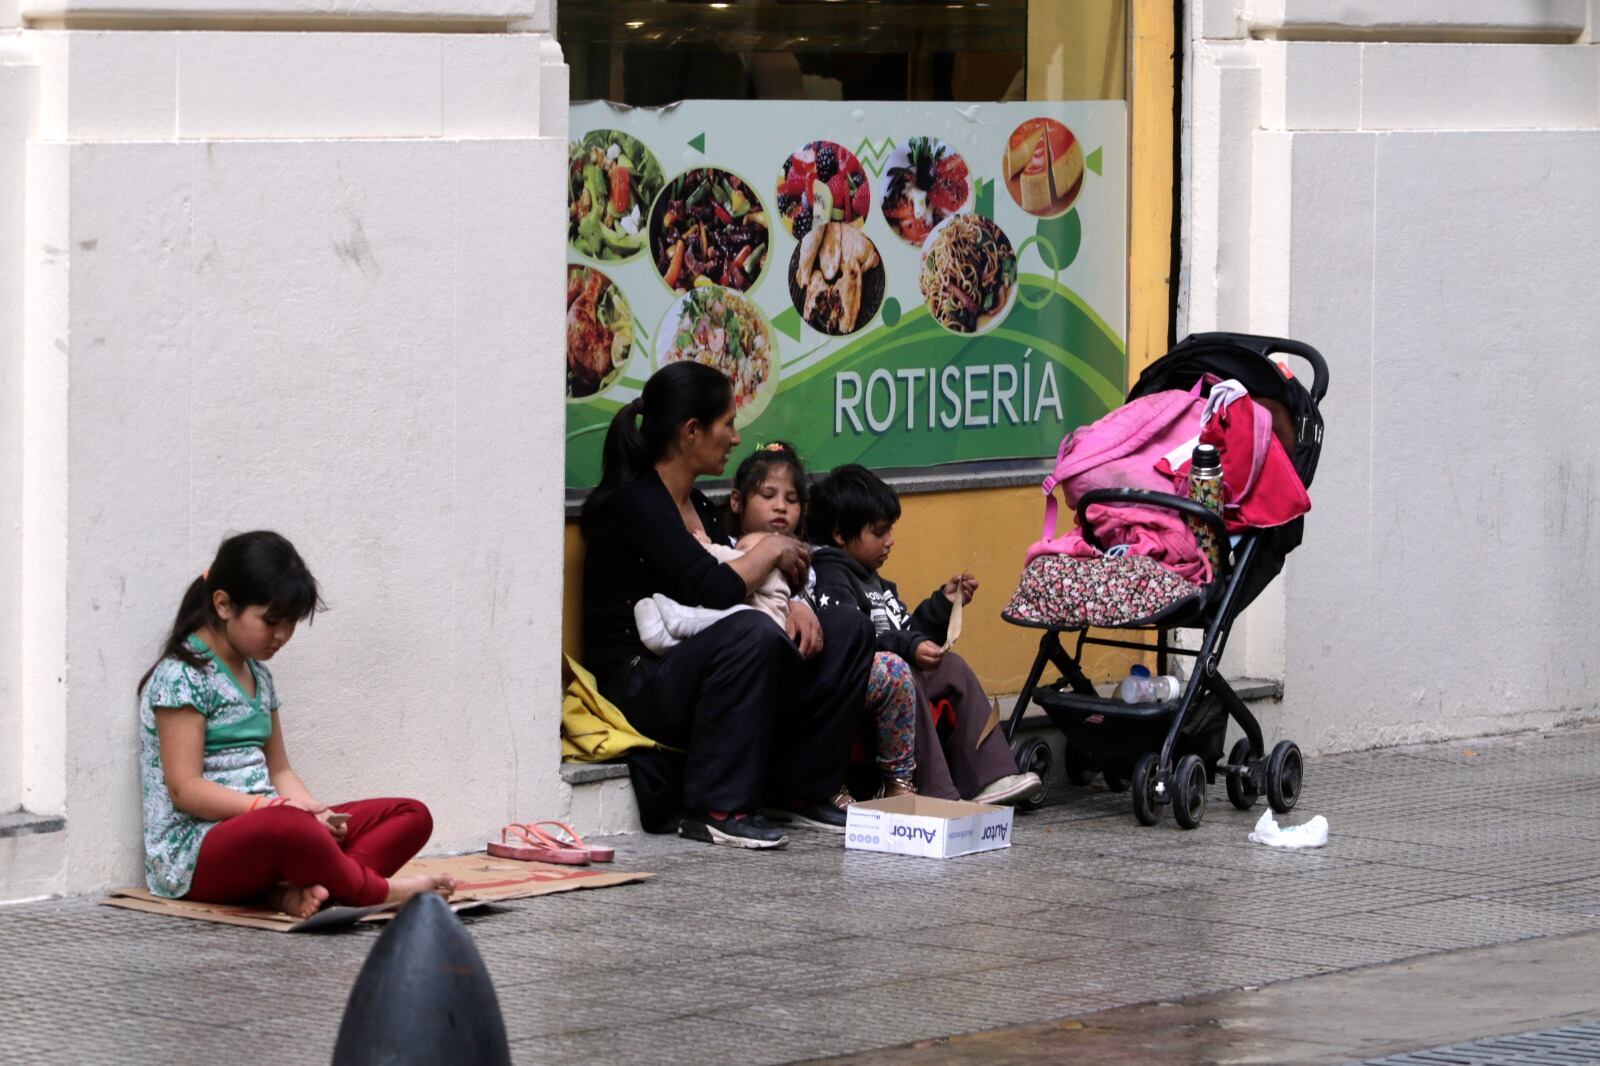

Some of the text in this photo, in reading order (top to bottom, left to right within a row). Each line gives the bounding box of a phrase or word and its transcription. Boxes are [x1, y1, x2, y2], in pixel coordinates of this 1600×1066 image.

[835, 348, 1063, 434] ROTISERÍA
[891, 825, 936, 843] Autor
[981, 822, 1008, 841] Autor
